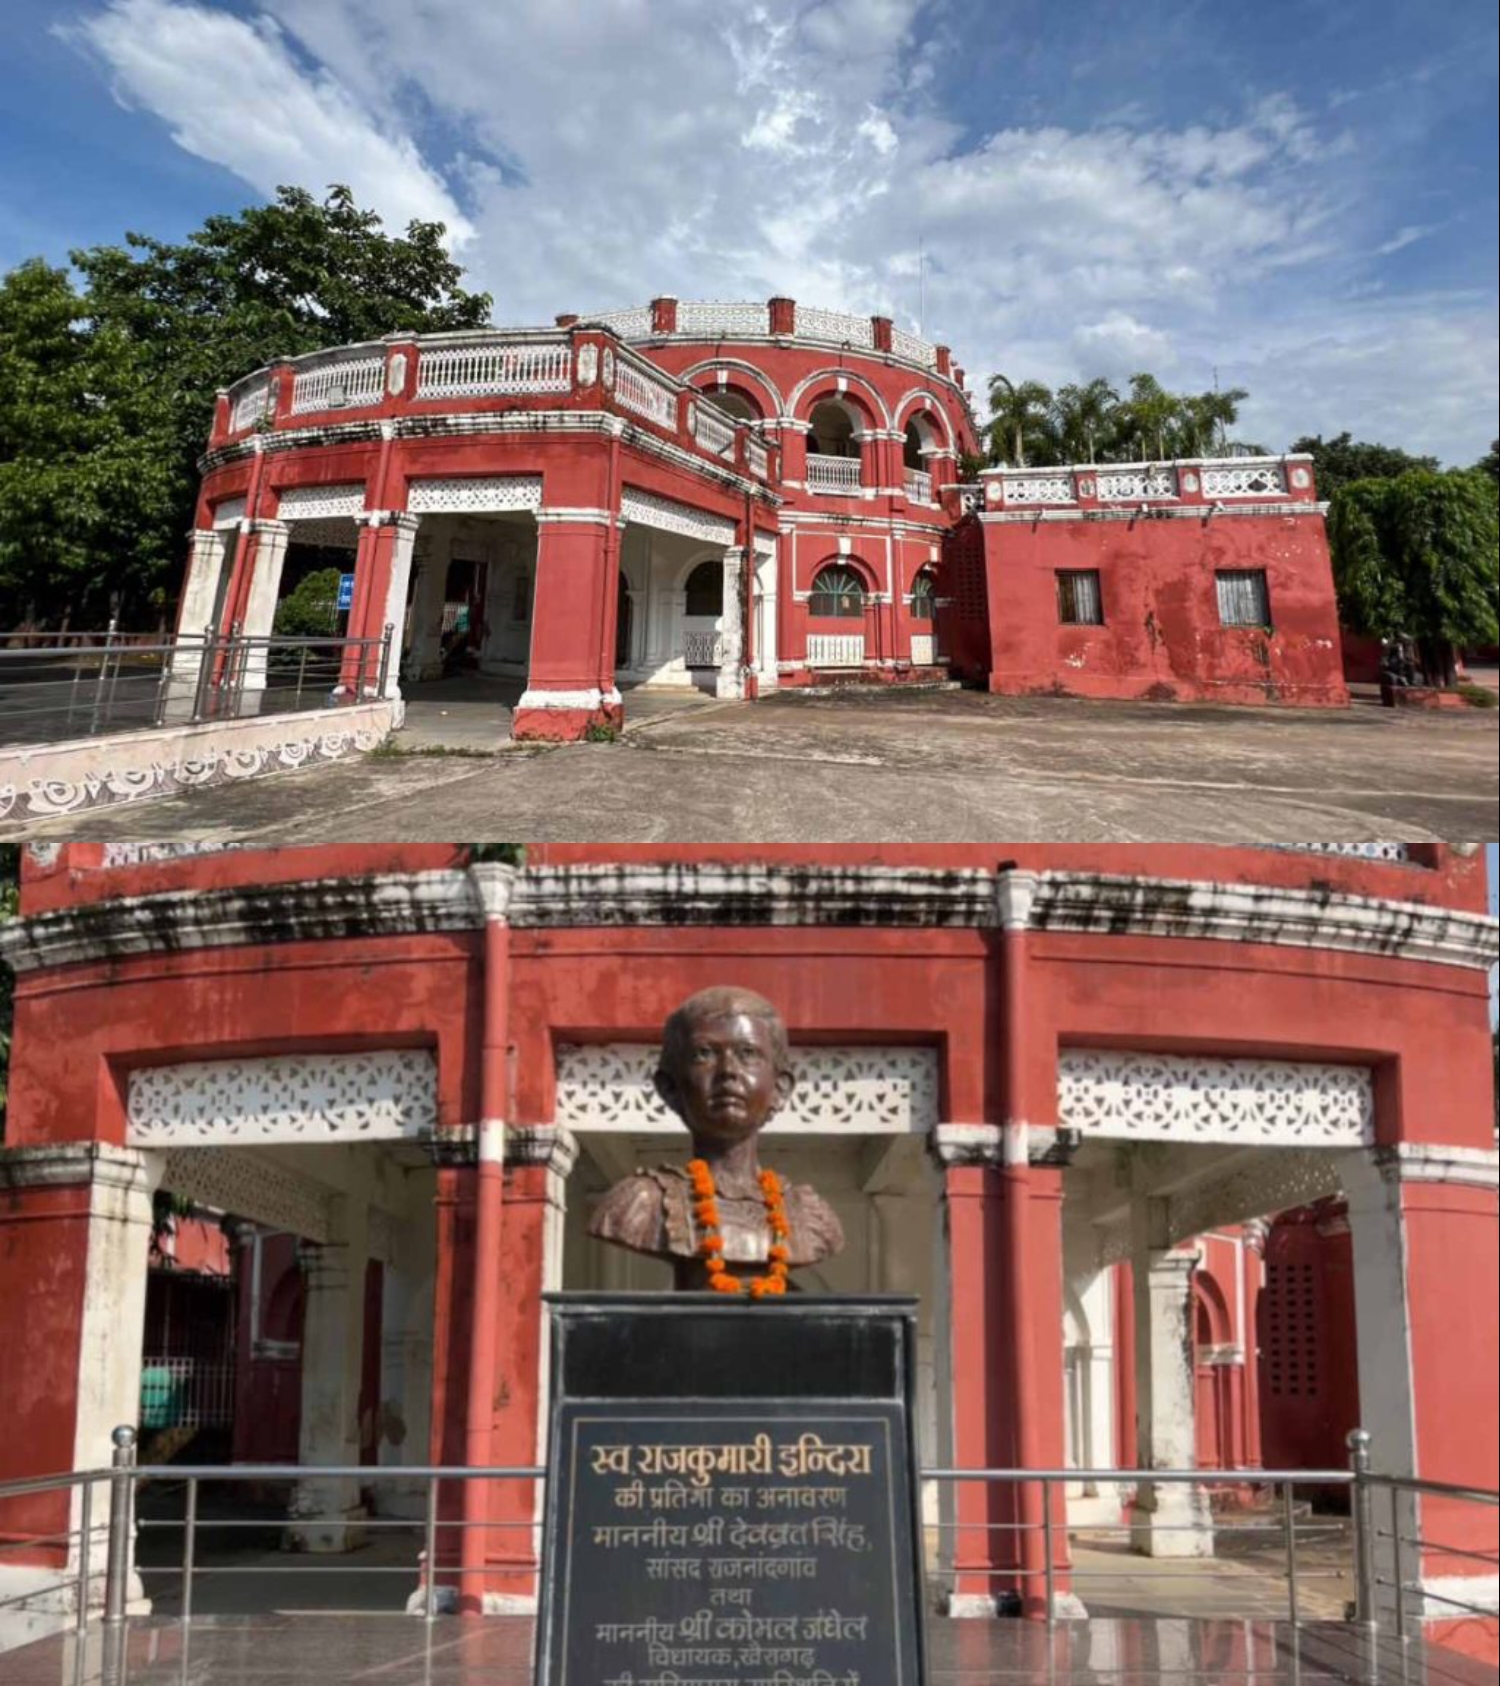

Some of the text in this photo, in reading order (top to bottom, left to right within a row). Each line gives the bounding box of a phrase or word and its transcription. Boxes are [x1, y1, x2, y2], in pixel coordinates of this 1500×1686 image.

[637, 1433, 773, 1487] राजकुमारी
[778, 1433, 872, 1477] इन्दिरा
[615, 1479, 646, 1509] की
[721, 1487, 751, 1509] का
[756, 1487, 849, 1509] अनावरण
[592, 1517, 688, 1548] माननीय
[691, 1516, 726, 1547] श्री
[645, 1551, 818, 1579] सांसद राजनांदगांव
[709, 1588, 753, 1606] तथा
[595, 1616, 675, 1643] माननीय
[678, 1609, 713, 1642] श्री
[715, 1608, 798, 1641] कोमल
